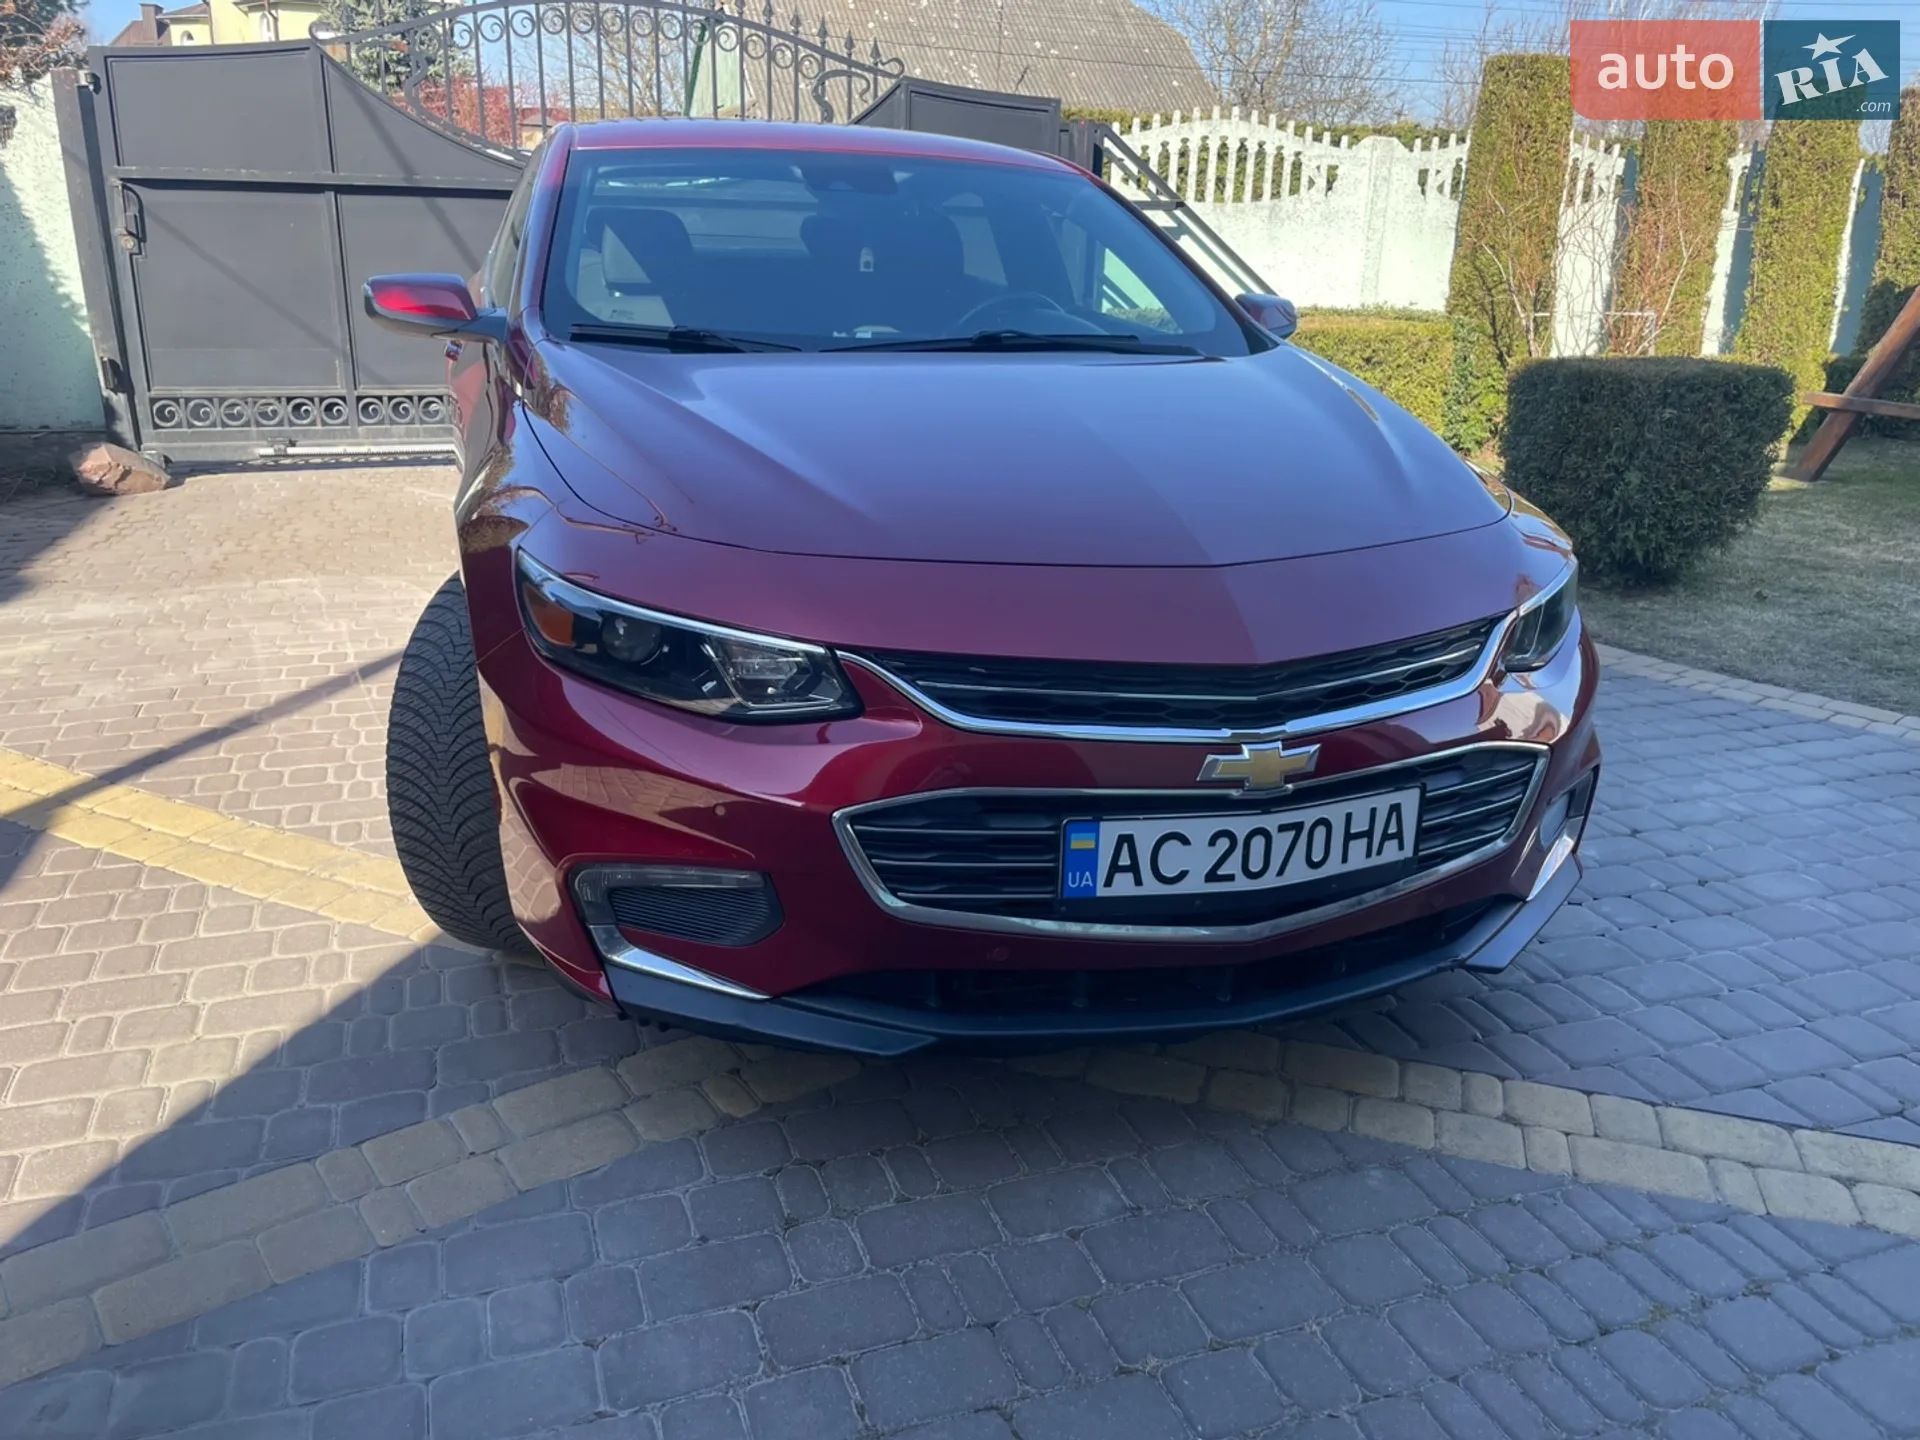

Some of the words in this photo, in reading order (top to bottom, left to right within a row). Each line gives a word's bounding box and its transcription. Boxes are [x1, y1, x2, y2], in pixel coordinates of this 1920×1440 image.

[1102, 831, 1192, 887] AC
[1204, 817, 1333, 883] 2070
[1341, 802, 1405, 864] HA
[1068, 871, 1093, 888] UA
